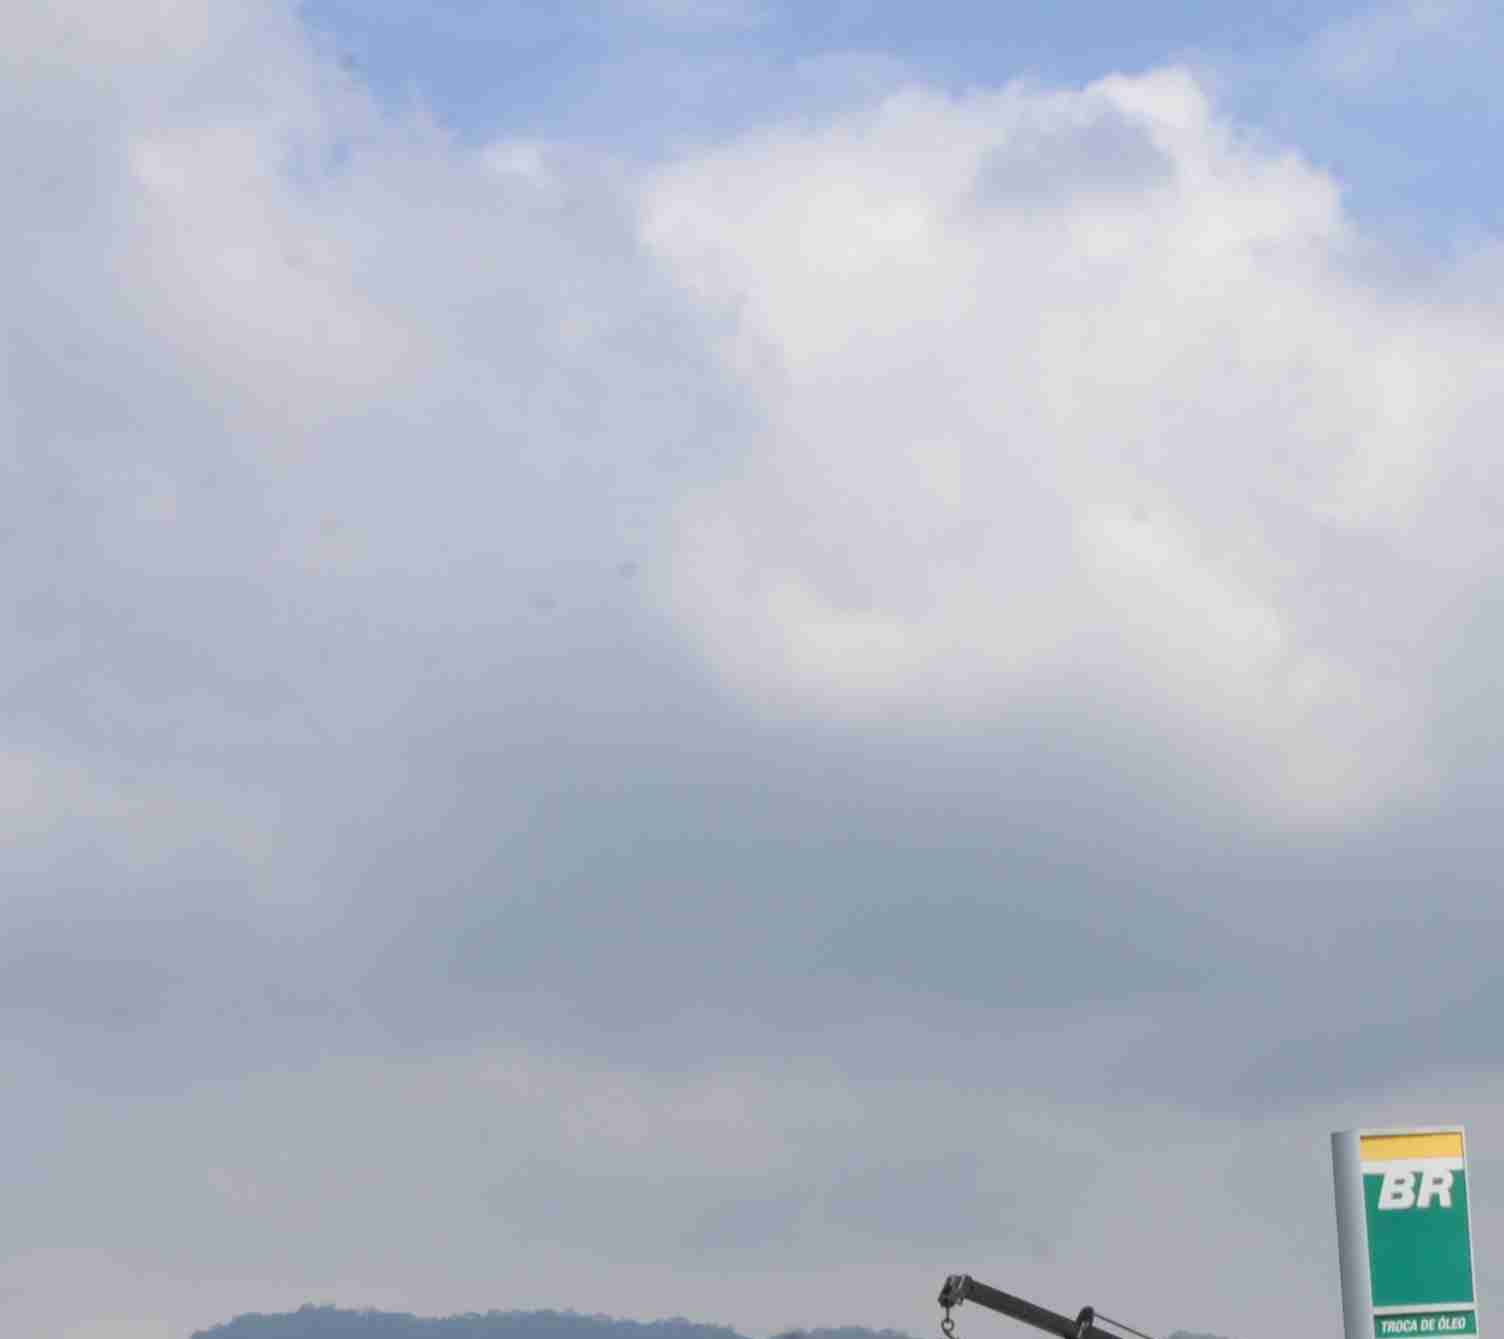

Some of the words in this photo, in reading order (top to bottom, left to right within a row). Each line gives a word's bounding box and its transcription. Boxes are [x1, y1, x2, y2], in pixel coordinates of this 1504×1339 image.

[1378, 1166, 1453, 1209] BR
[1381, 1319, 1417, 1333] TROCA
[1421, 1317, 1436, 1331] DE
[1438, 1315, 1466, 1330] ÓLEO
